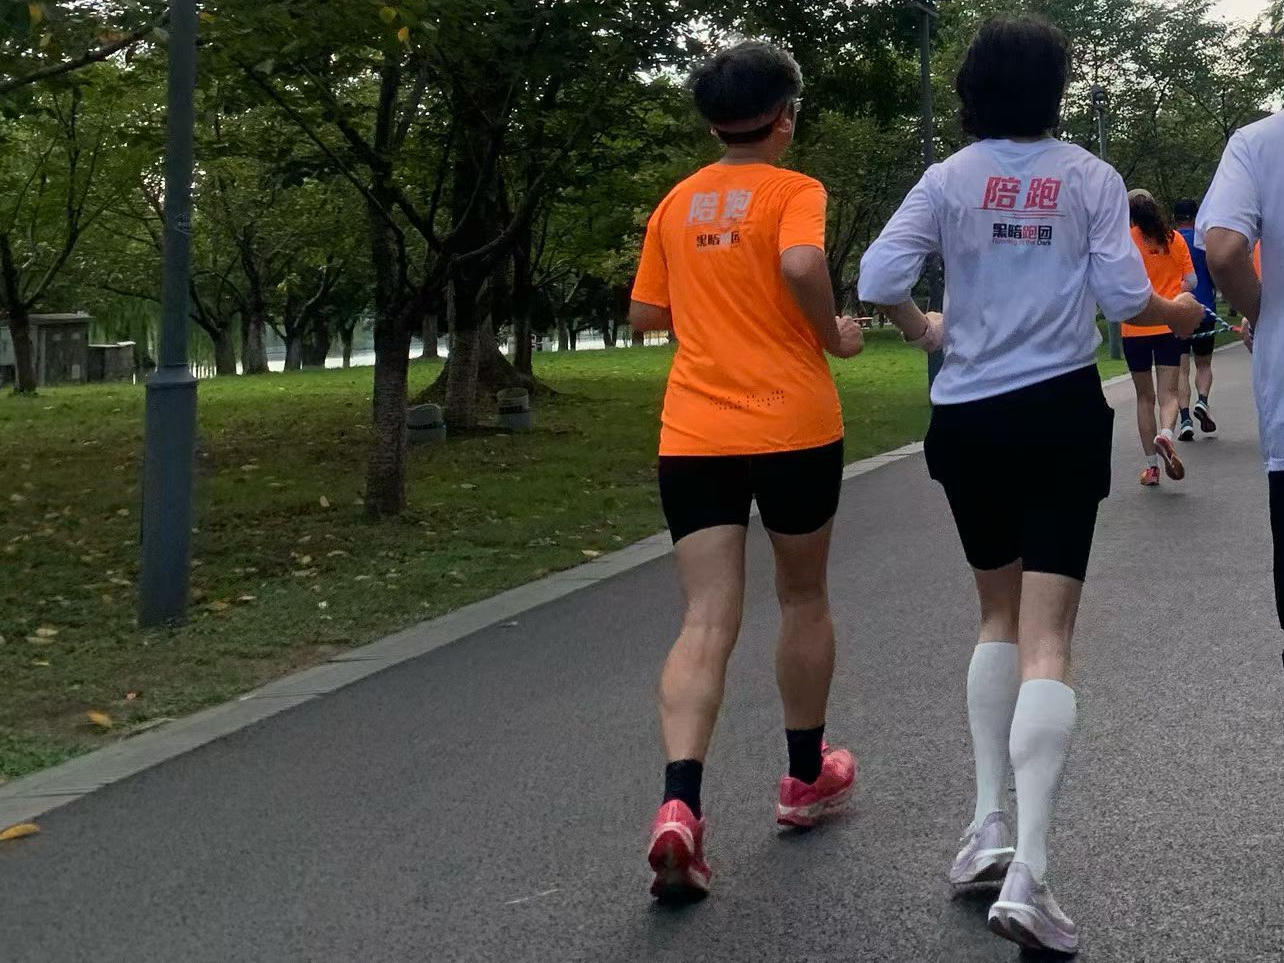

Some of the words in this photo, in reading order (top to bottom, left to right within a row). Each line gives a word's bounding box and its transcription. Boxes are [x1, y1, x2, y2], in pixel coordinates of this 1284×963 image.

[688, 189, 752, 222] 陪跑
[982, 177, 1061, 209] 陪跑
[992, 223, 1052, 239] 黑暗跑团
